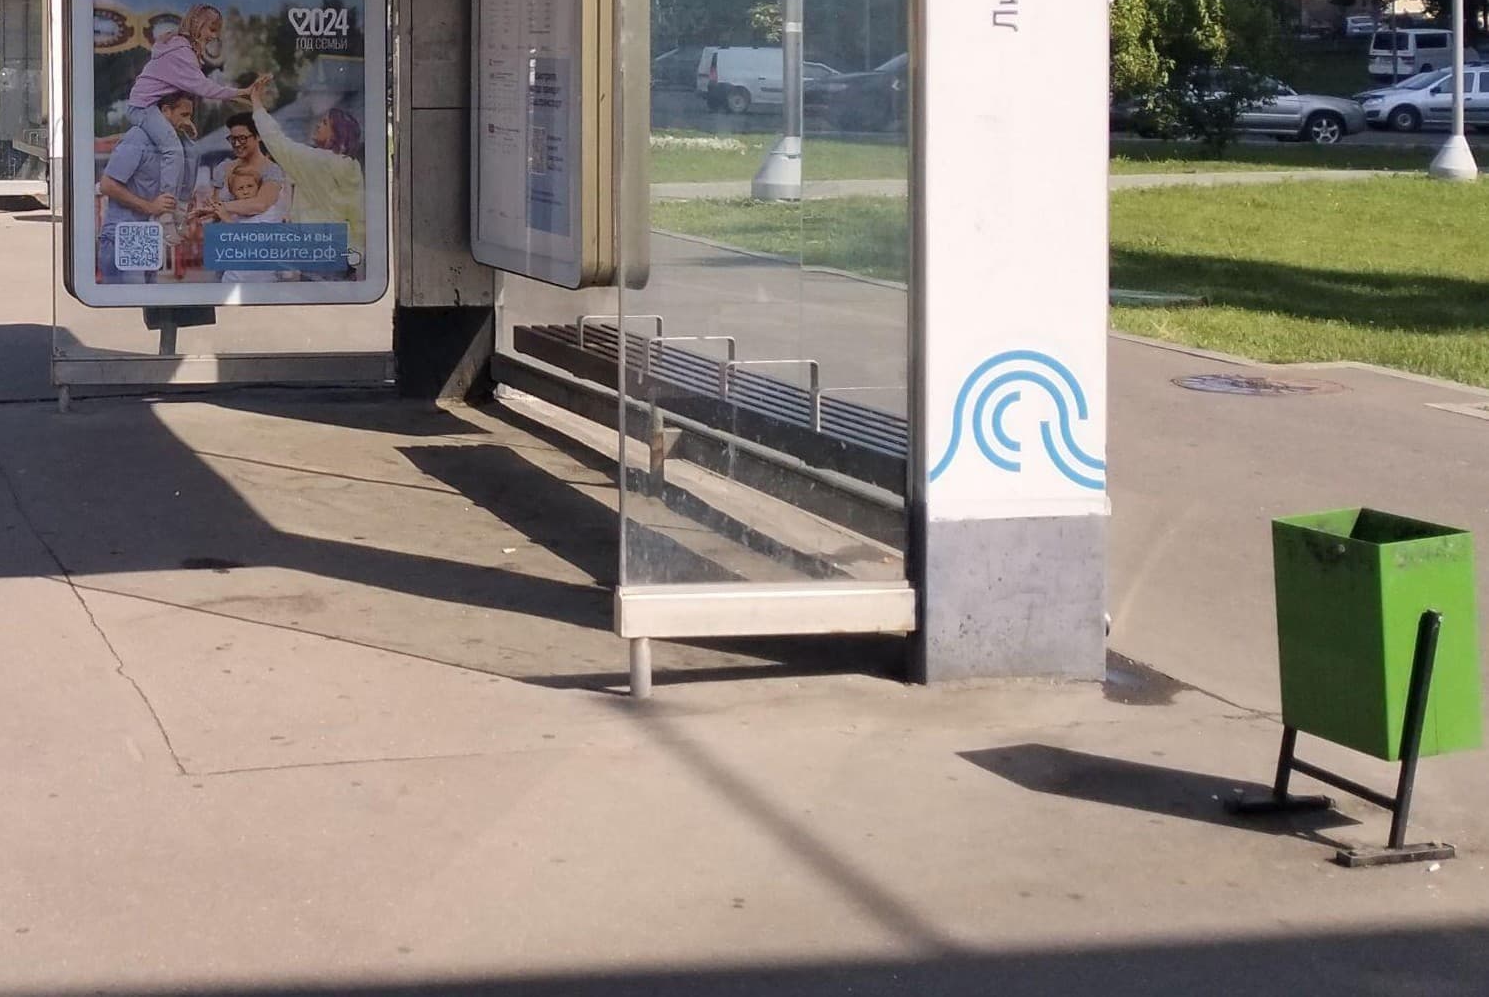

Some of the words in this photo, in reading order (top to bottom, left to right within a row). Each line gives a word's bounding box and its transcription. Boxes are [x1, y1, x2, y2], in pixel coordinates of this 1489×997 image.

[288, 7, 350, 36] 2024
[295, 37, 314, 51] ГОД
[315, 37, 348, 51] СЕМЬИ
[220, 233, 301, 242] СТАНОВИТЕСЬ
[314, 233, 333, 242] ВЫ
[215, 245, 337, 262] усыновите.рф
